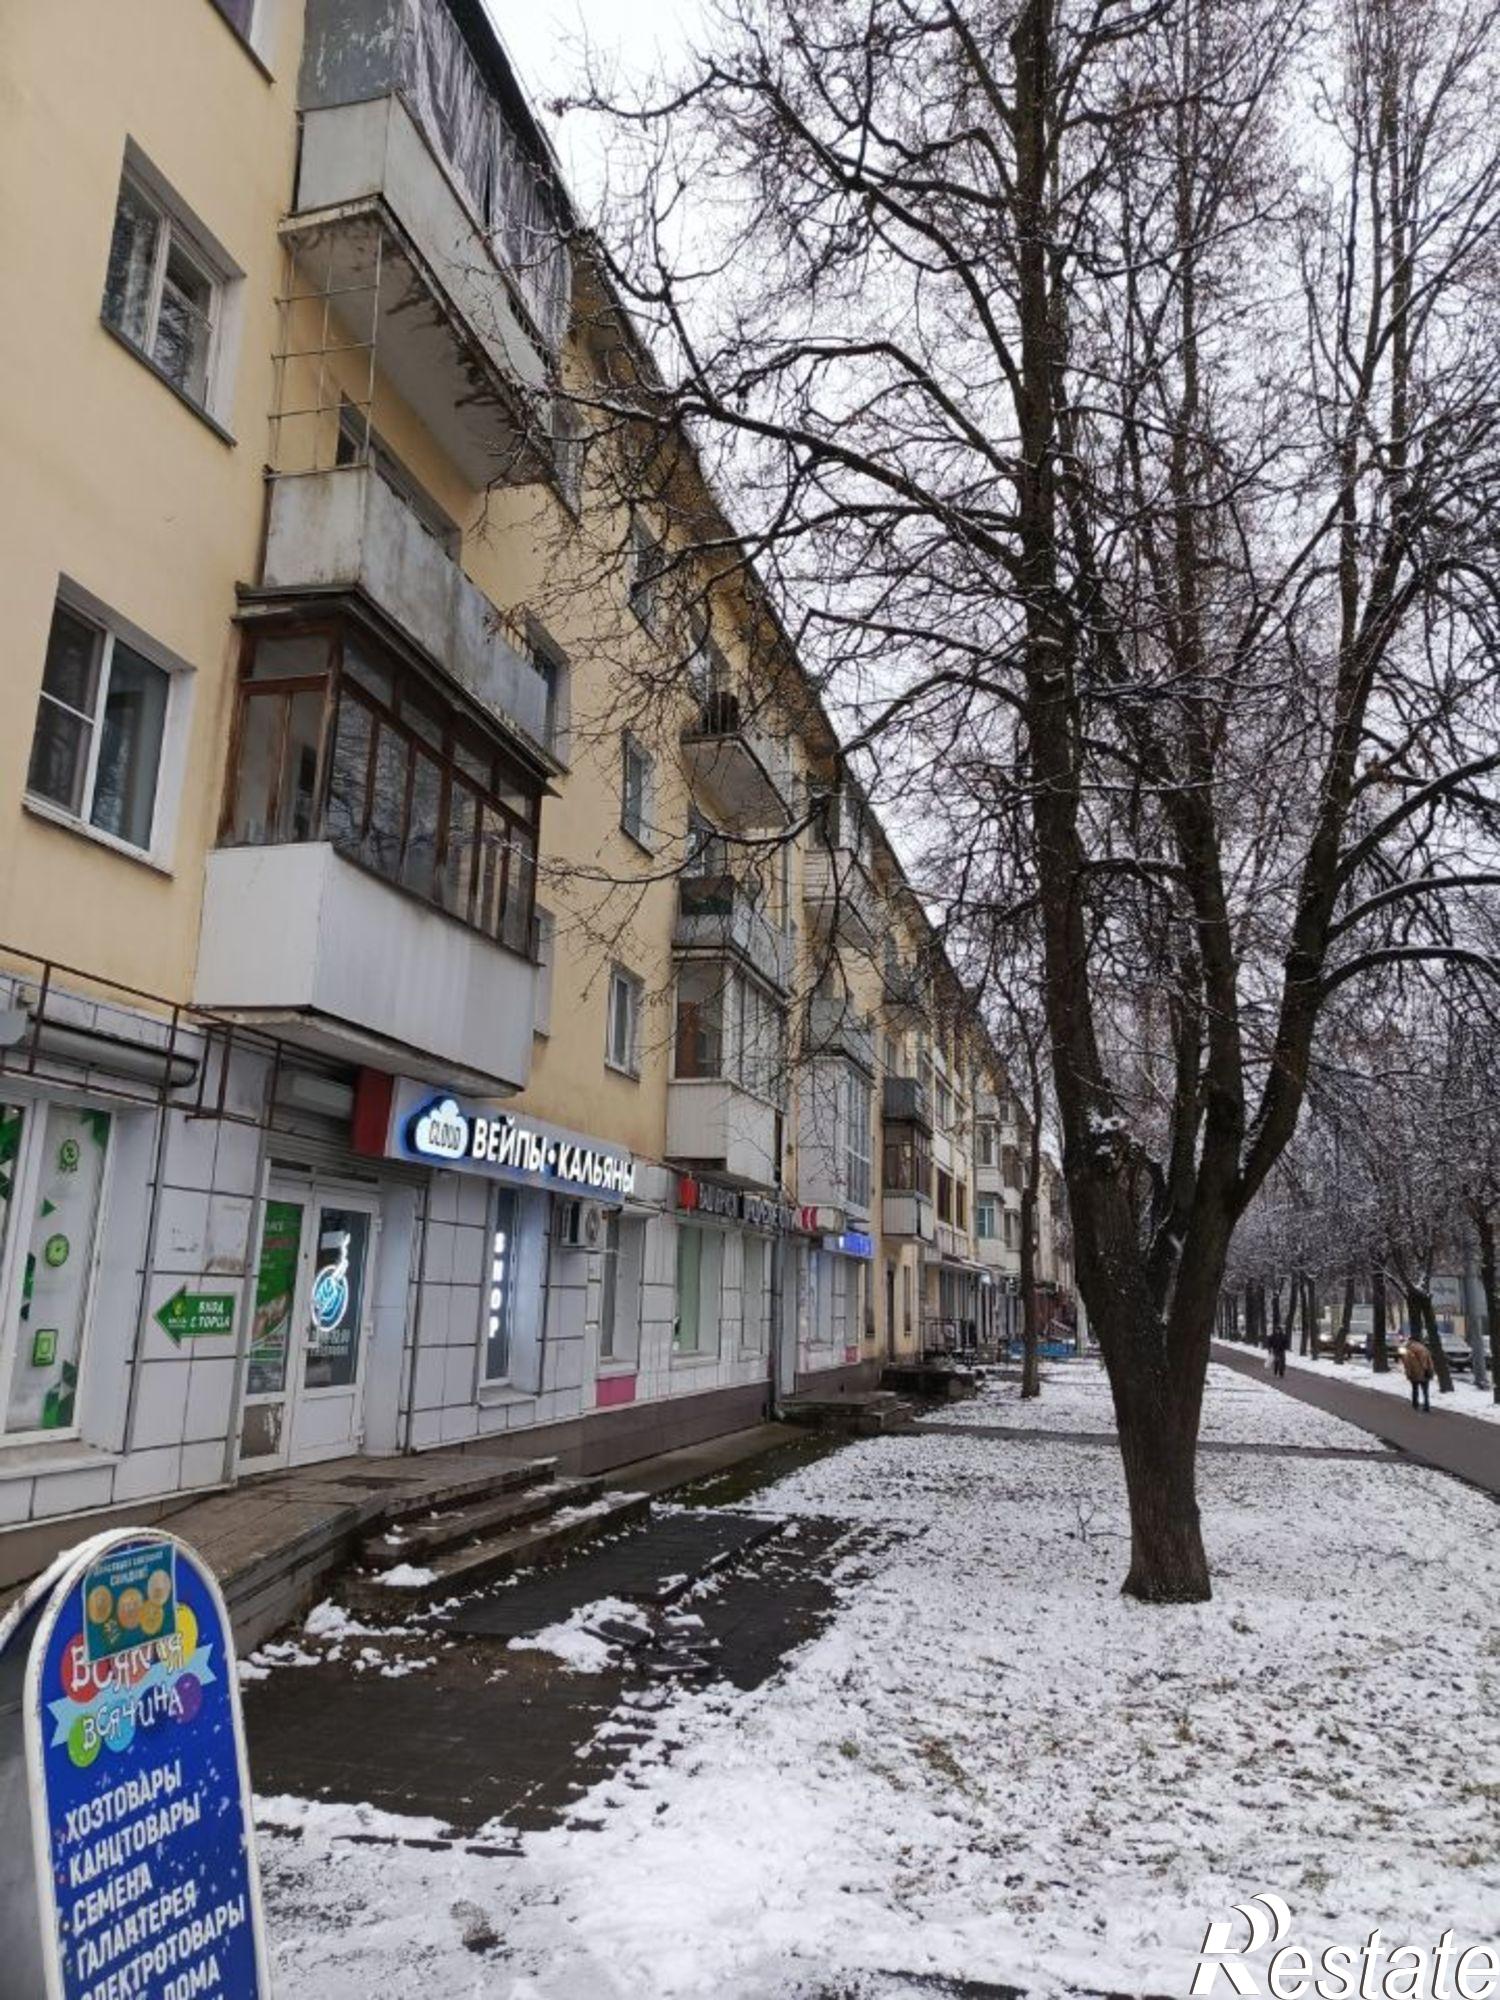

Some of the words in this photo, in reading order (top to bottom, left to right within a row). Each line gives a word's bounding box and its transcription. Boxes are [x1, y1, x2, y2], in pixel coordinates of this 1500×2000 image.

[428, 1118, 462, 1151] CLOUD
[472, 1116, 547, 1173] ВЕЙПЫ
[557, 1142, 637, 1193] КАЛЬЯНЫ
[82, 1681, 184, 1750] ВСЯЧИНА
[65, 1759, 182, 1844] ХОЗТОВАРЫ
[69, 1791, 200, 1888] КАНЦТОВАРЫ
[72, 1862, 153, 1937] СЕМЕНА
[76, 1878, 197, 1981] ГАЛАНТЕРЕЯ
[80, 1893, 245, 2000] ЛЕКТРОТОВАРЫ
[163, 1953, 221, 2000] ДОМА
